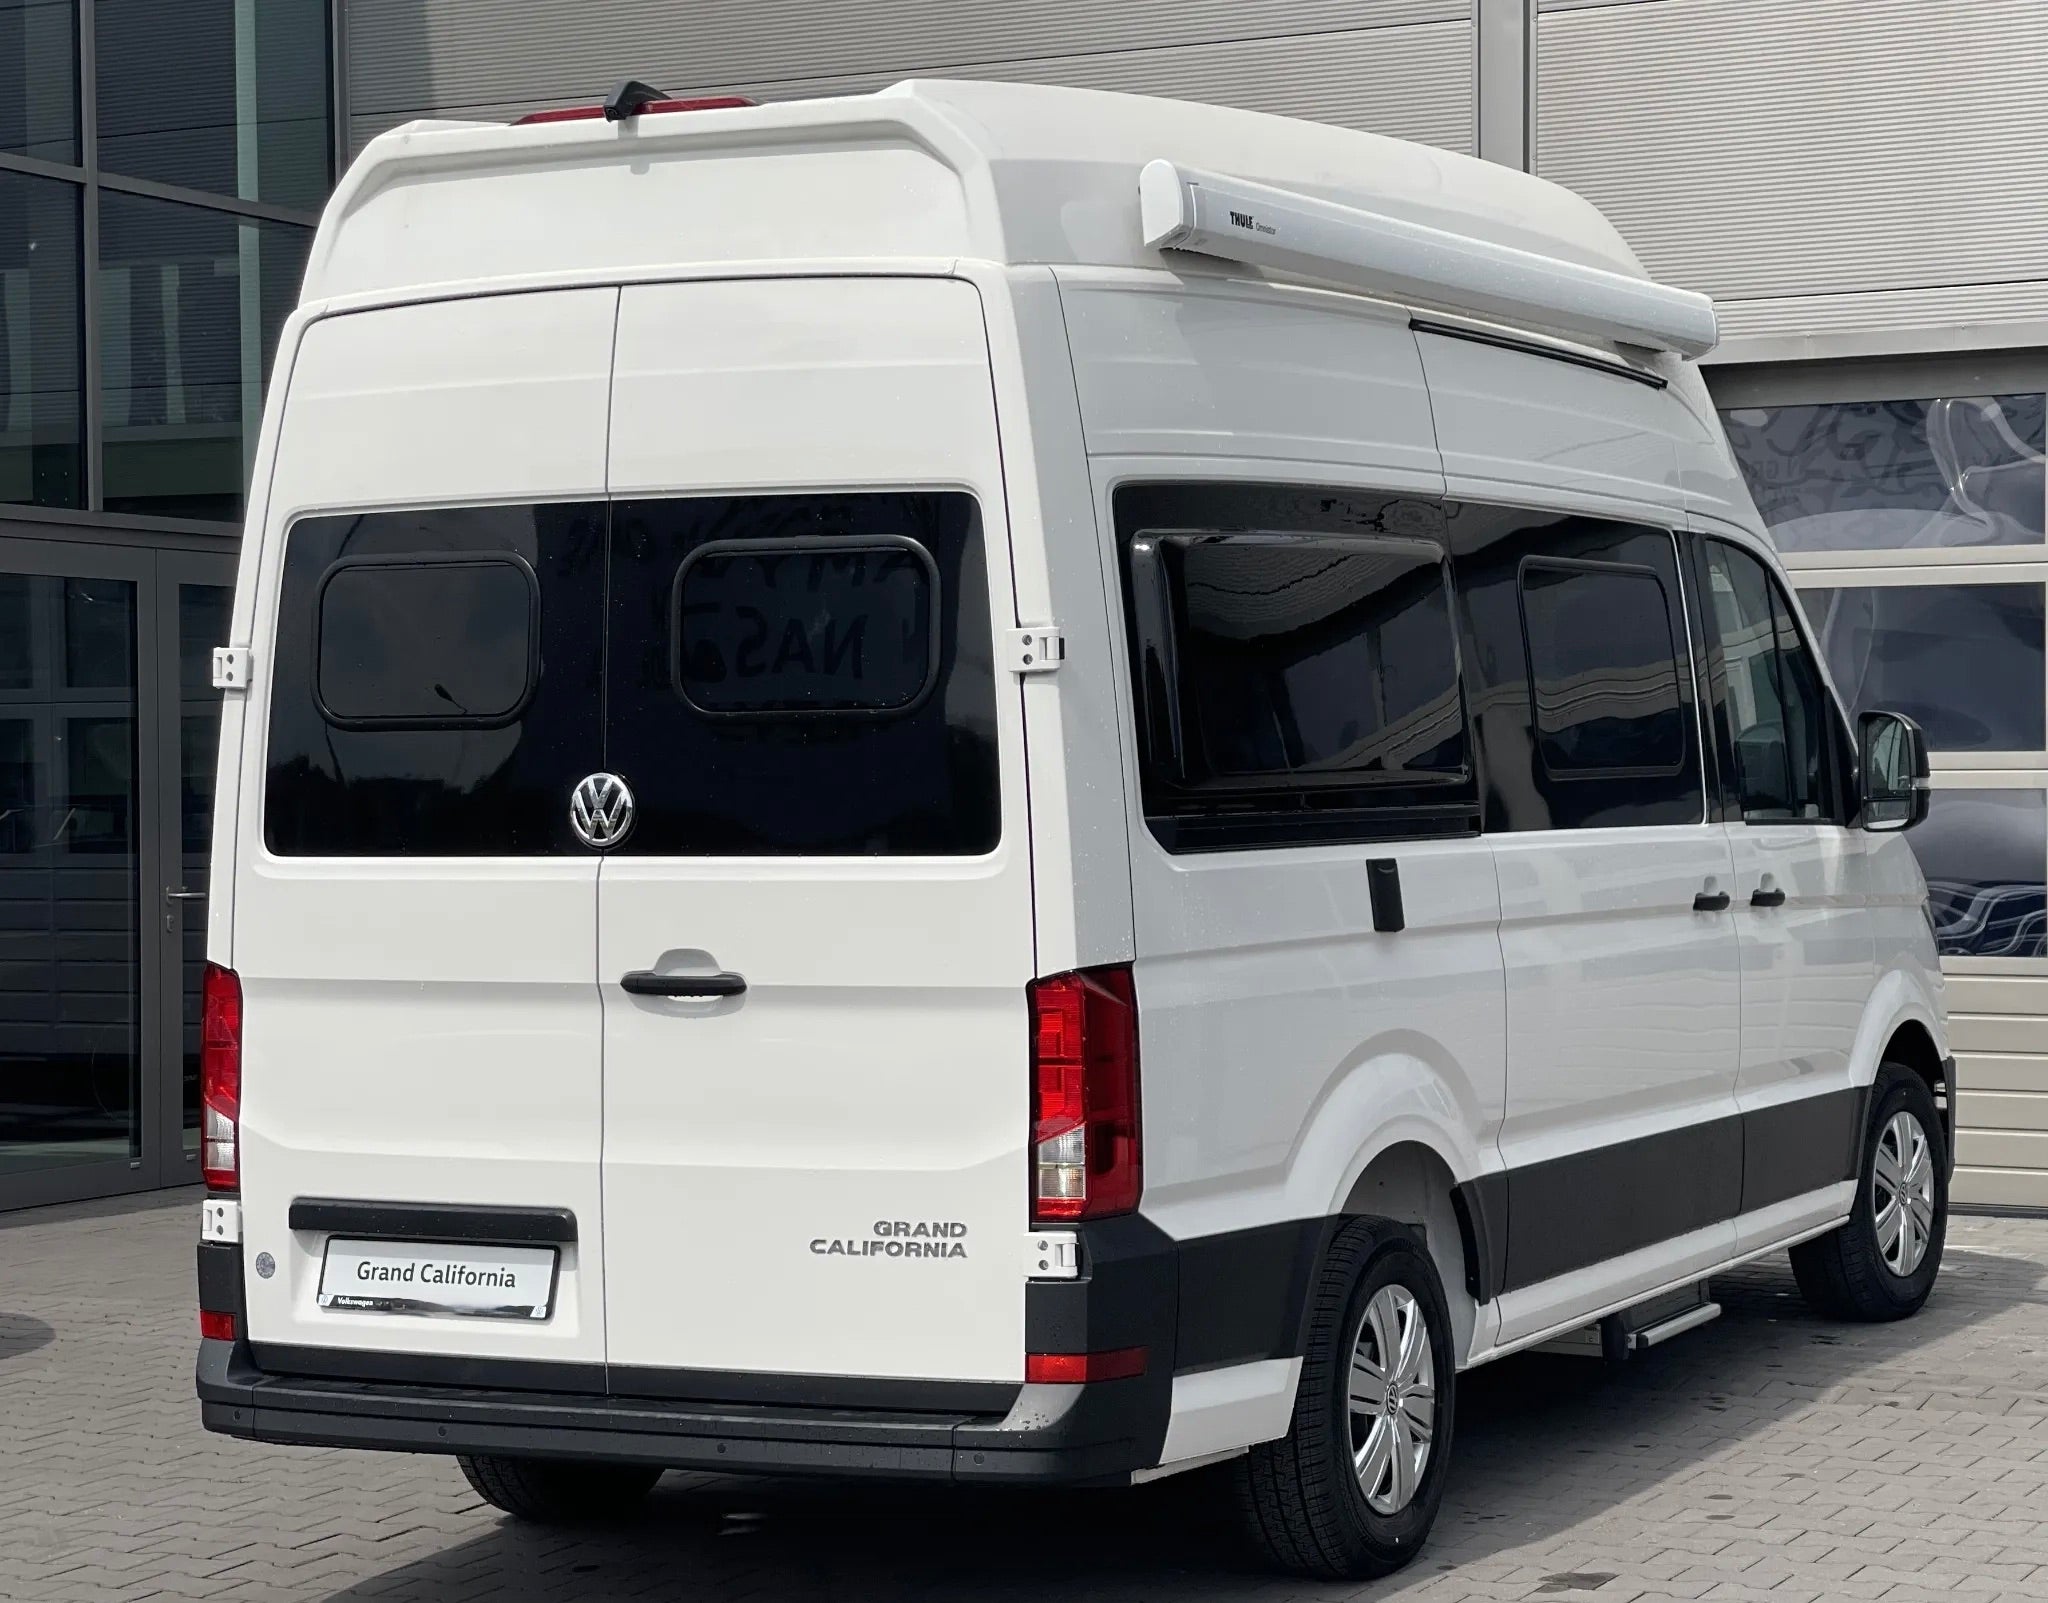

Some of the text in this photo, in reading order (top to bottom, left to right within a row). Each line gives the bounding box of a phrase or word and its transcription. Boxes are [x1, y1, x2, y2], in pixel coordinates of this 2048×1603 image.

[1229, 211, 1254, 230] THULE
[873, 1220, 968, 1238] GRAND
[809, 1239, 968, 1258] CALIFORNIA
[357, 1261, 516, 1288] Grand California
